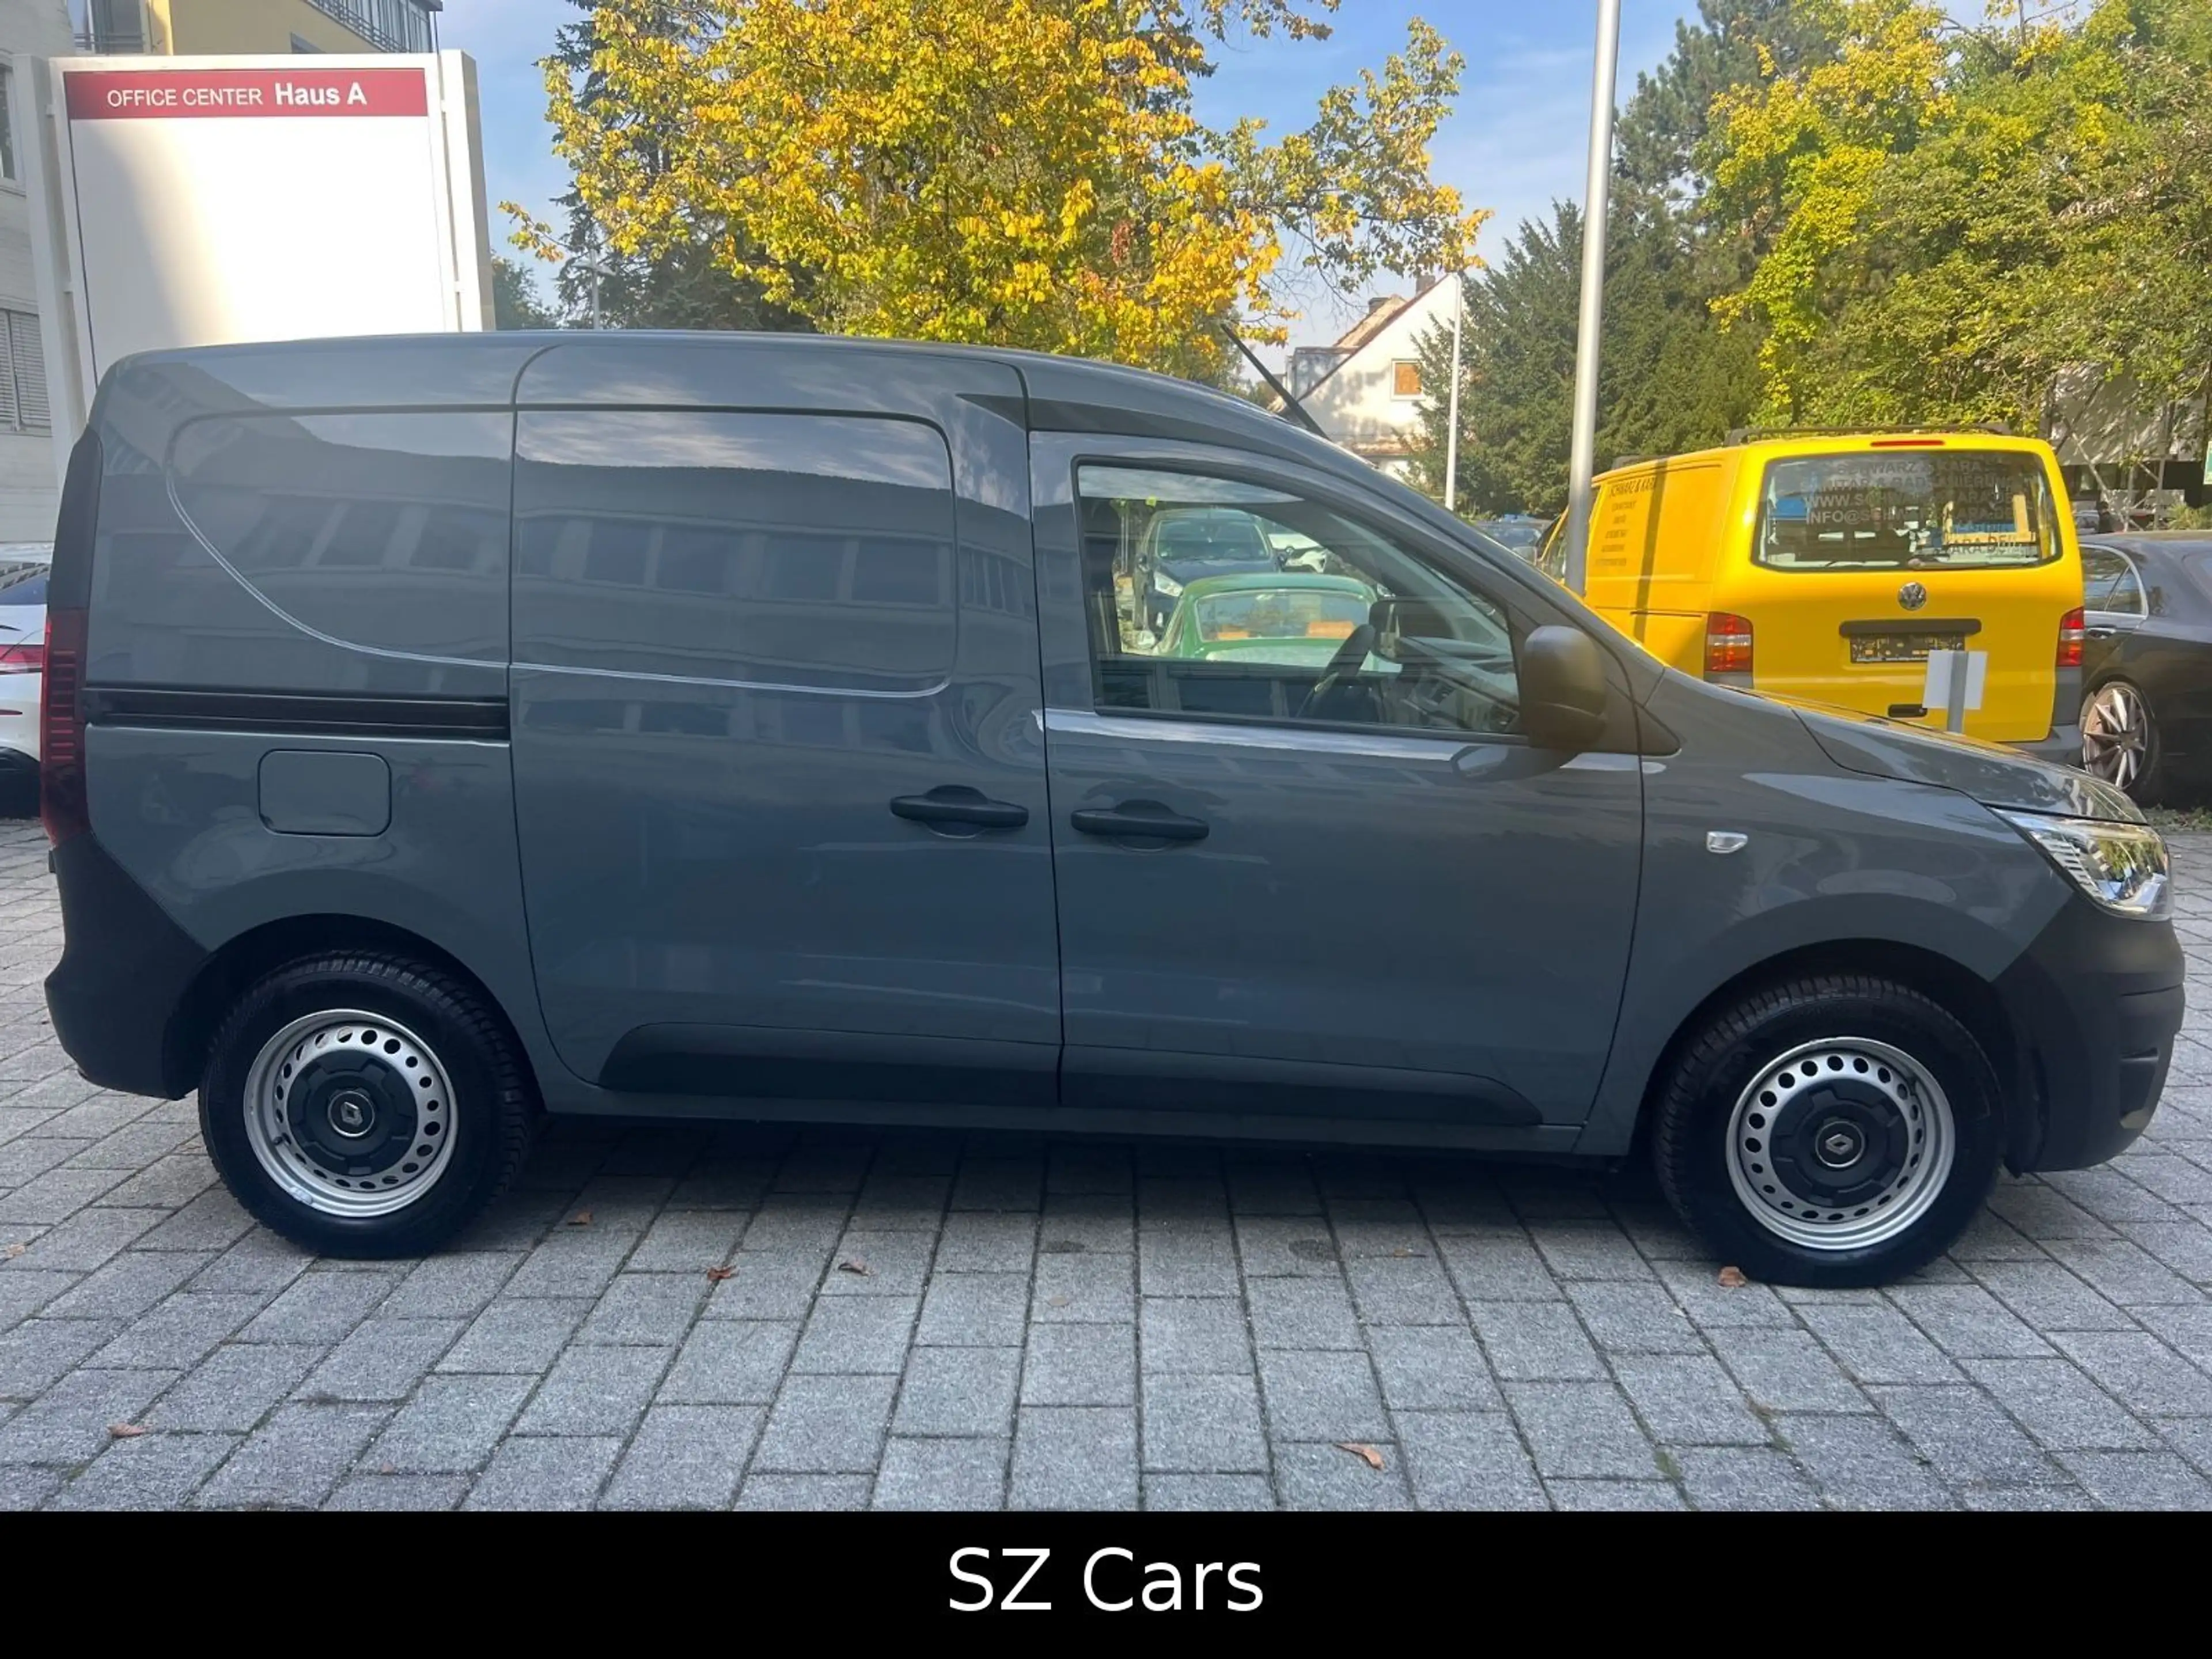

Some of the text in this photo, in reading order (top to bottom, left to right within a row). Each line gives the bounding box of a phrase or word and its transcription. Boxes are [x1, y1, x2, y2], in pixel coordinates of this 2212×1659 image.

[107, 82, 367, 107] OFFICE CENTER Haus A
